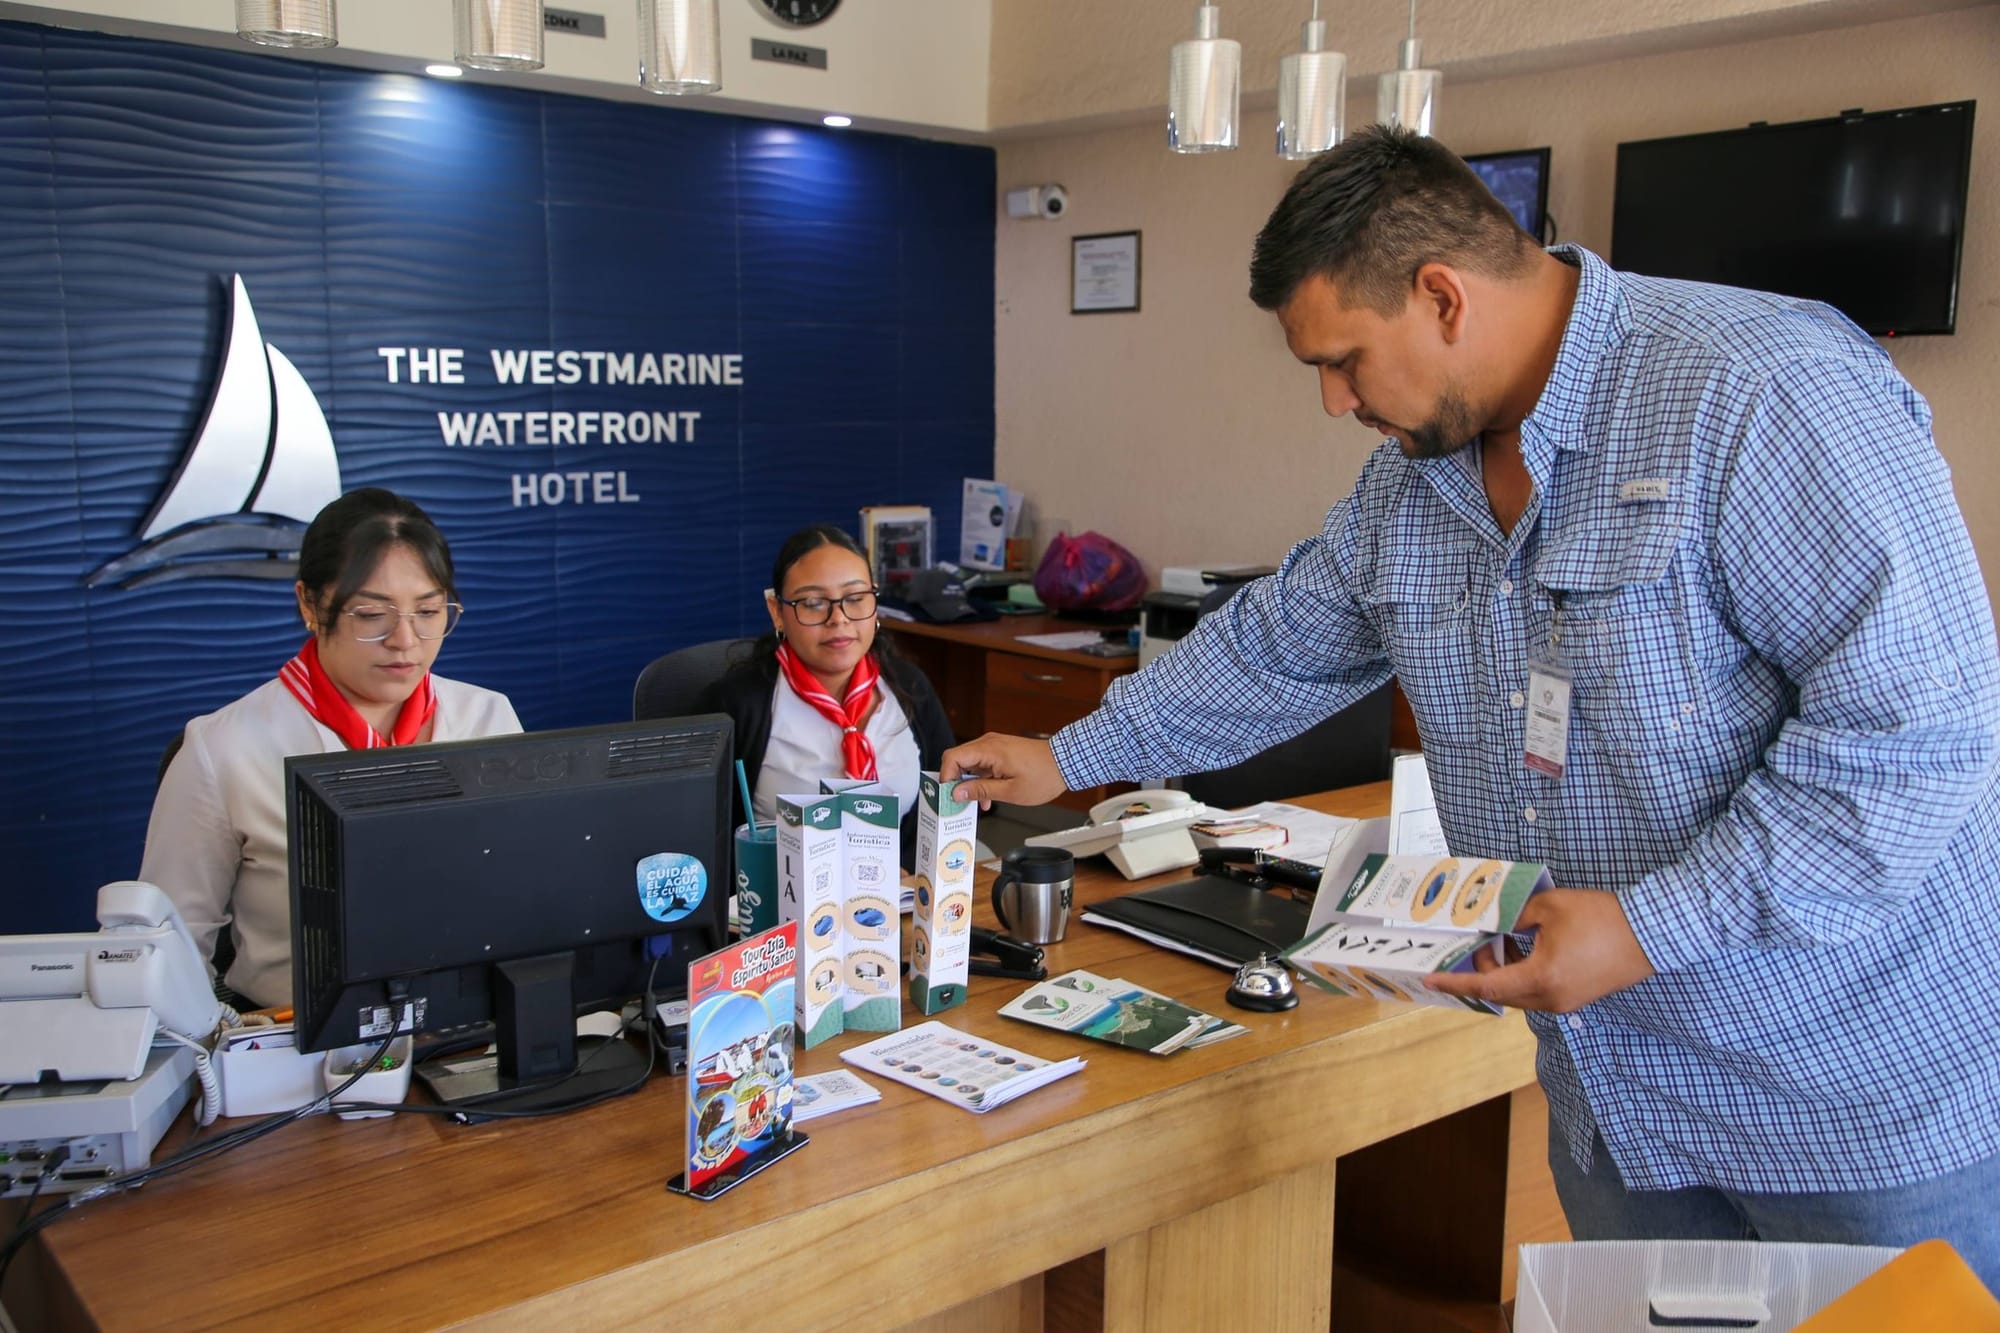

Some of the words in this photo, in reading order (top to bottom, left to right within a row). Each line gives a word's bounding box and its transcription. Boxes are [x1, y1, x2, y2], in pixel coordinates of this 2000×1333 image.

[771, 47, 785, 58] LA
[787, 49, 808, 63] PAZ
[378, 347, 465, 384] THE
[490, 349, 744, 385] WESTMARINE
[437, 411, 701, 447] WATERFRONT
[512, 471, 640, 507] HOTEL
[647, 864, 699, 880] CUIDAR
[646, 880, 662, 890] EL
[664, 875, 699, 889] AGUA
[646, 890, 659, 898] ES
[661, 884, 699, 896] CUIDAR
[647, 897, 666, 909] LA
[742, 947, 766, 967] Tour
[766, 936, 785, 955] Isla
[770, 947, 795, 970] Santo
[31, 963, 74, 971] Panasonic
